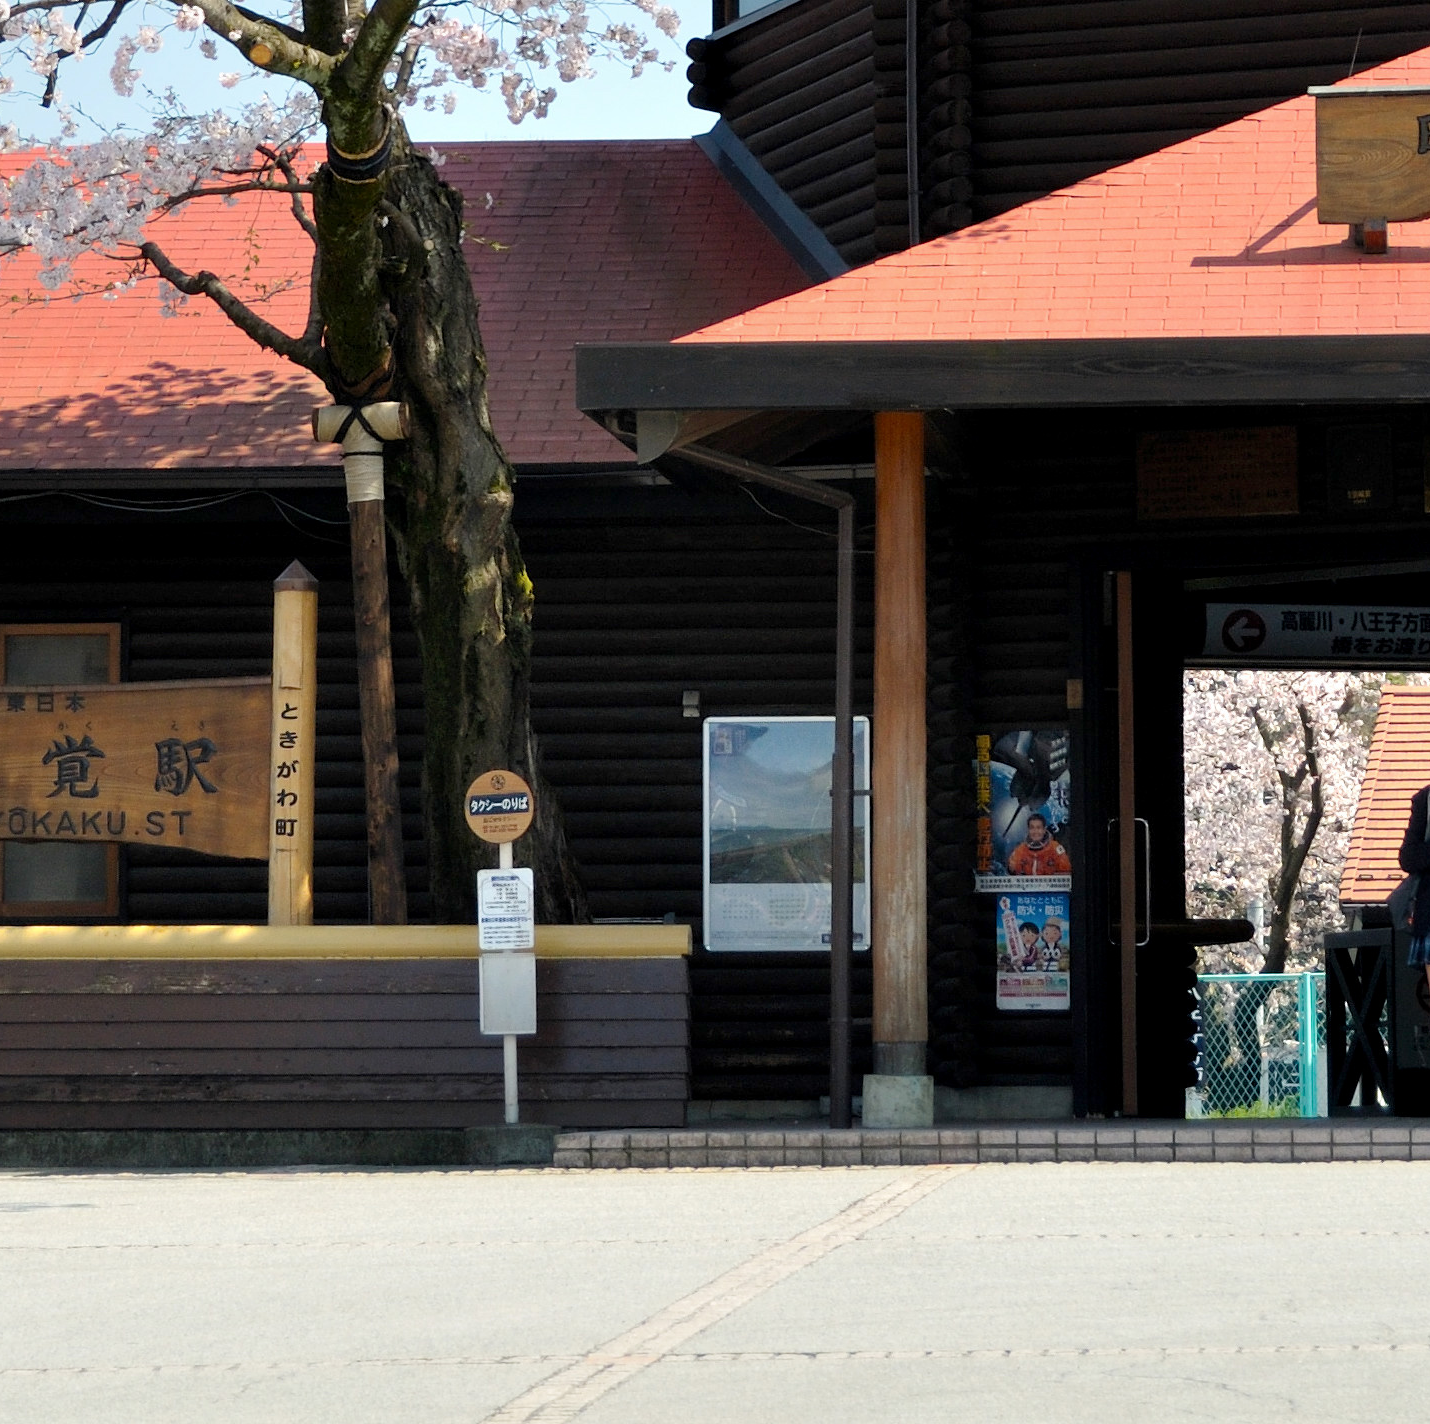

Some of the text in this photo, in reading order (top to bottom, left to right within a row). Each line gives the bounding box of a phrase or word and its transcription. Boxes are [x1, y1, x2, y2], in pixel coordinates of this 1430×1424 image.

[275, 702, 299, 837] ときがわ町
[471, 796, 528, 813] タクシーのりば
